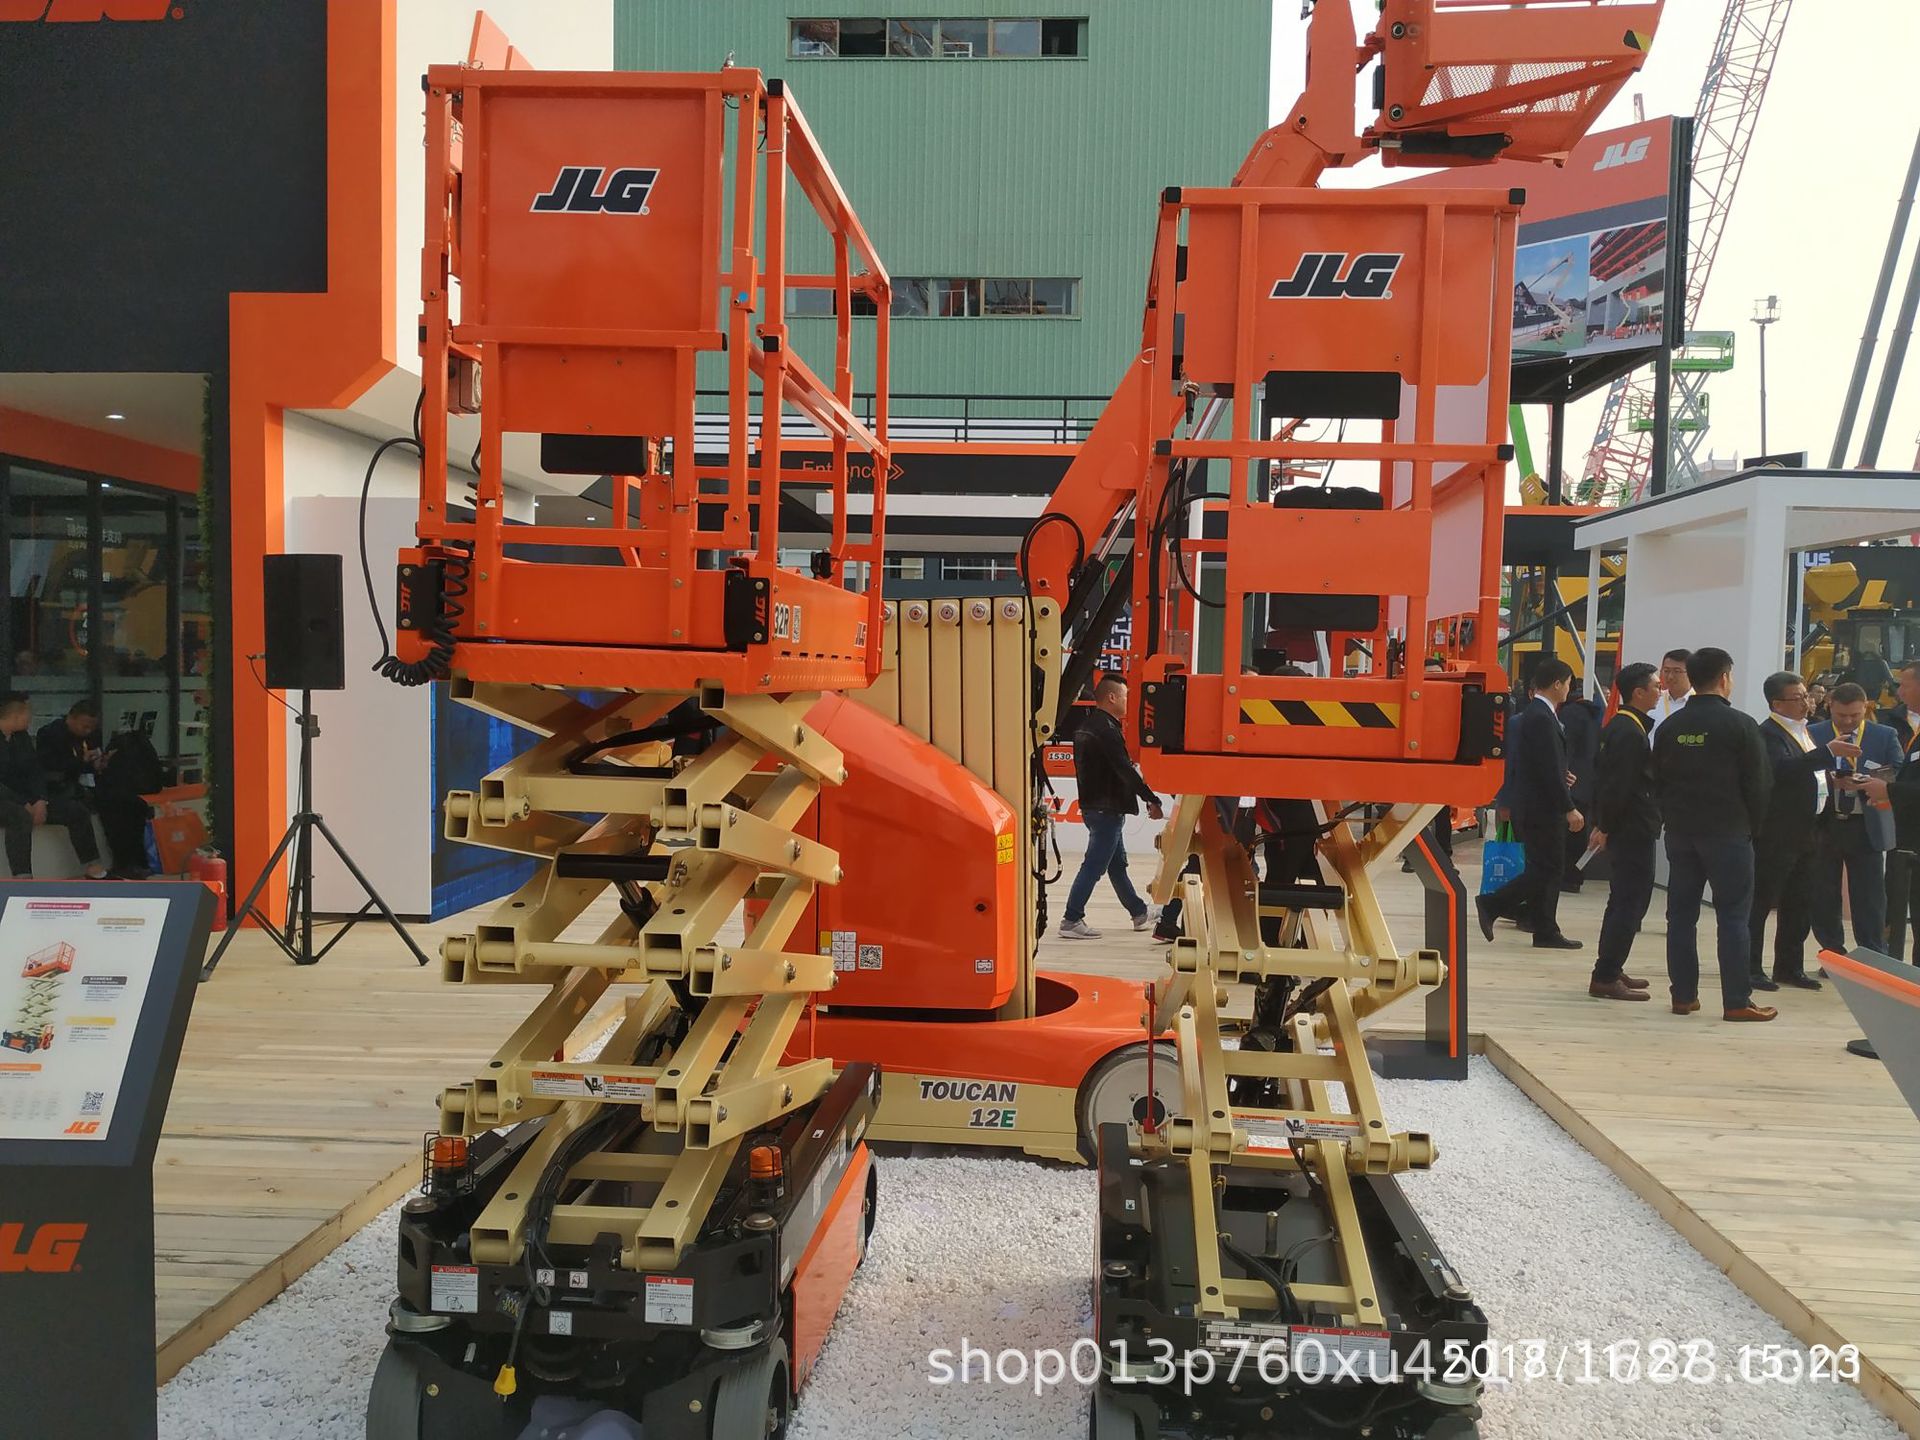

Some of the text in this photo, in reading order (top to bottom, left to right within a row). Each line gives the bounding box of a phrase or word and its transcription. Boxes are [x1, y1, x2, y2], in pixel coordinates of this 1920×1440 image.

[1592, 136, 1652, 171] JLG
[529, 166, 661, 215] JLG
[1268, 252, 1405, 299] JLG
[802, 460, 879, 479] Entnc
[755, 595, 766, 626] JLG
[1144, 698, 1155, 730] JLG
[1493, 710, 1505, 742] JLG
[920, 1080, 1018, 1103] TOUCAN
[64, 1120, 101, 1135] JLG
[969, 1108, 1017, 1128] 12E
